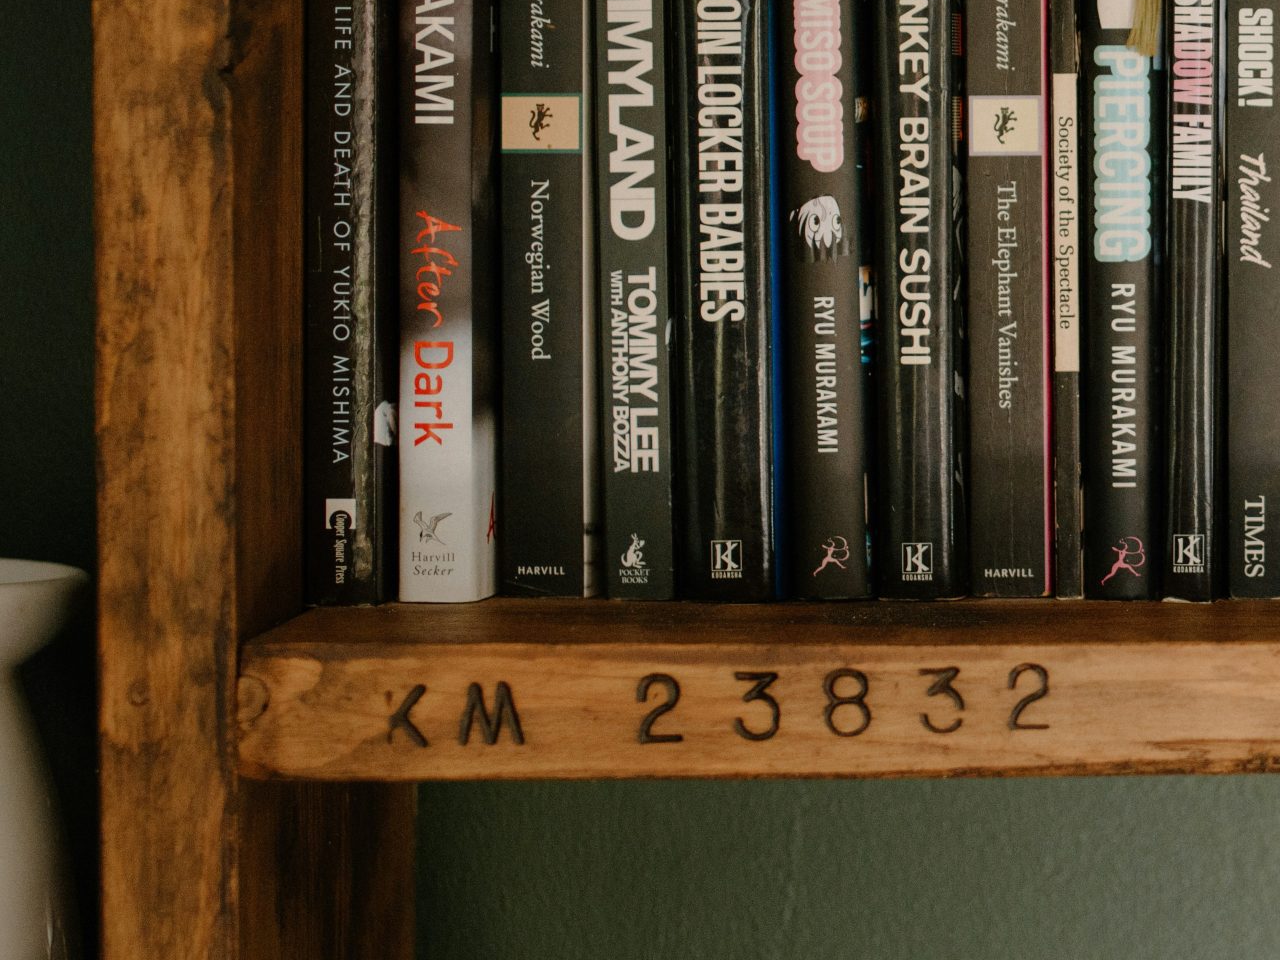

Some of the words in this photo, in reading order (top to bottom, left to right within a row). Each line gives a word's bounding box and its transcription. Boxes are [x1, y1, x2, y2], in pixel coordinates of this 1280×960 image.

[334, 6, 352, 50] LIFE
[1237, 8, 1274, 107] SHOCK!
[697, 65, 743, 193] LOCKER
[802, 80, 836, 164] SOUP
[1056, 116, 1074, 183] Society
[1098, 48, 1148, 258] PIERCING
[333, 131, 351, 206] DEATH
[899, 117, 930, 233] BRAIN
[1238, 152, 1272, 269] Thailand
[333, 220, 350, 251] OF
[411, 210, 462, 328] After
[525, 178, 550, 295] Norwegian
[698, 203, 745, 323] BABIES
[991, 226, 1018, 317] Elephant
[531, 298, 551, 360] Wood
[813, 296, 835, 335] RYU
[899, 248, 931, 365] SUSHI
[1056, 245, 1075, 330] Spectacle
[1111, 283, 1136, 332] RYU
[611, 308, 630, 403] ANTHONY
[627, 266, 659, 403] TOMMY
[998, 321, 1019, 409] Vanishes
[414, 341, 454, 447] Dark
[815, 343, 839, 454] MURAKAMI
[1111, 345, 1137, 488] MURAKAMI
[613, 406, 631, 473] BOZZA
[630, 407, 660, 474] LEE
[335, 512, 348, 537] Cooper
[335, 539, 348, 563] Square
[411, 551, 455, 562] Harvill
[1244, 495, 1265, 578] TIMES
[335, 564, 347, 584] Press
[412, 564, 454, 576] Secker
[619, 568, 650, 577] POCKET
[621, 576, 648, 584] BOOKS
